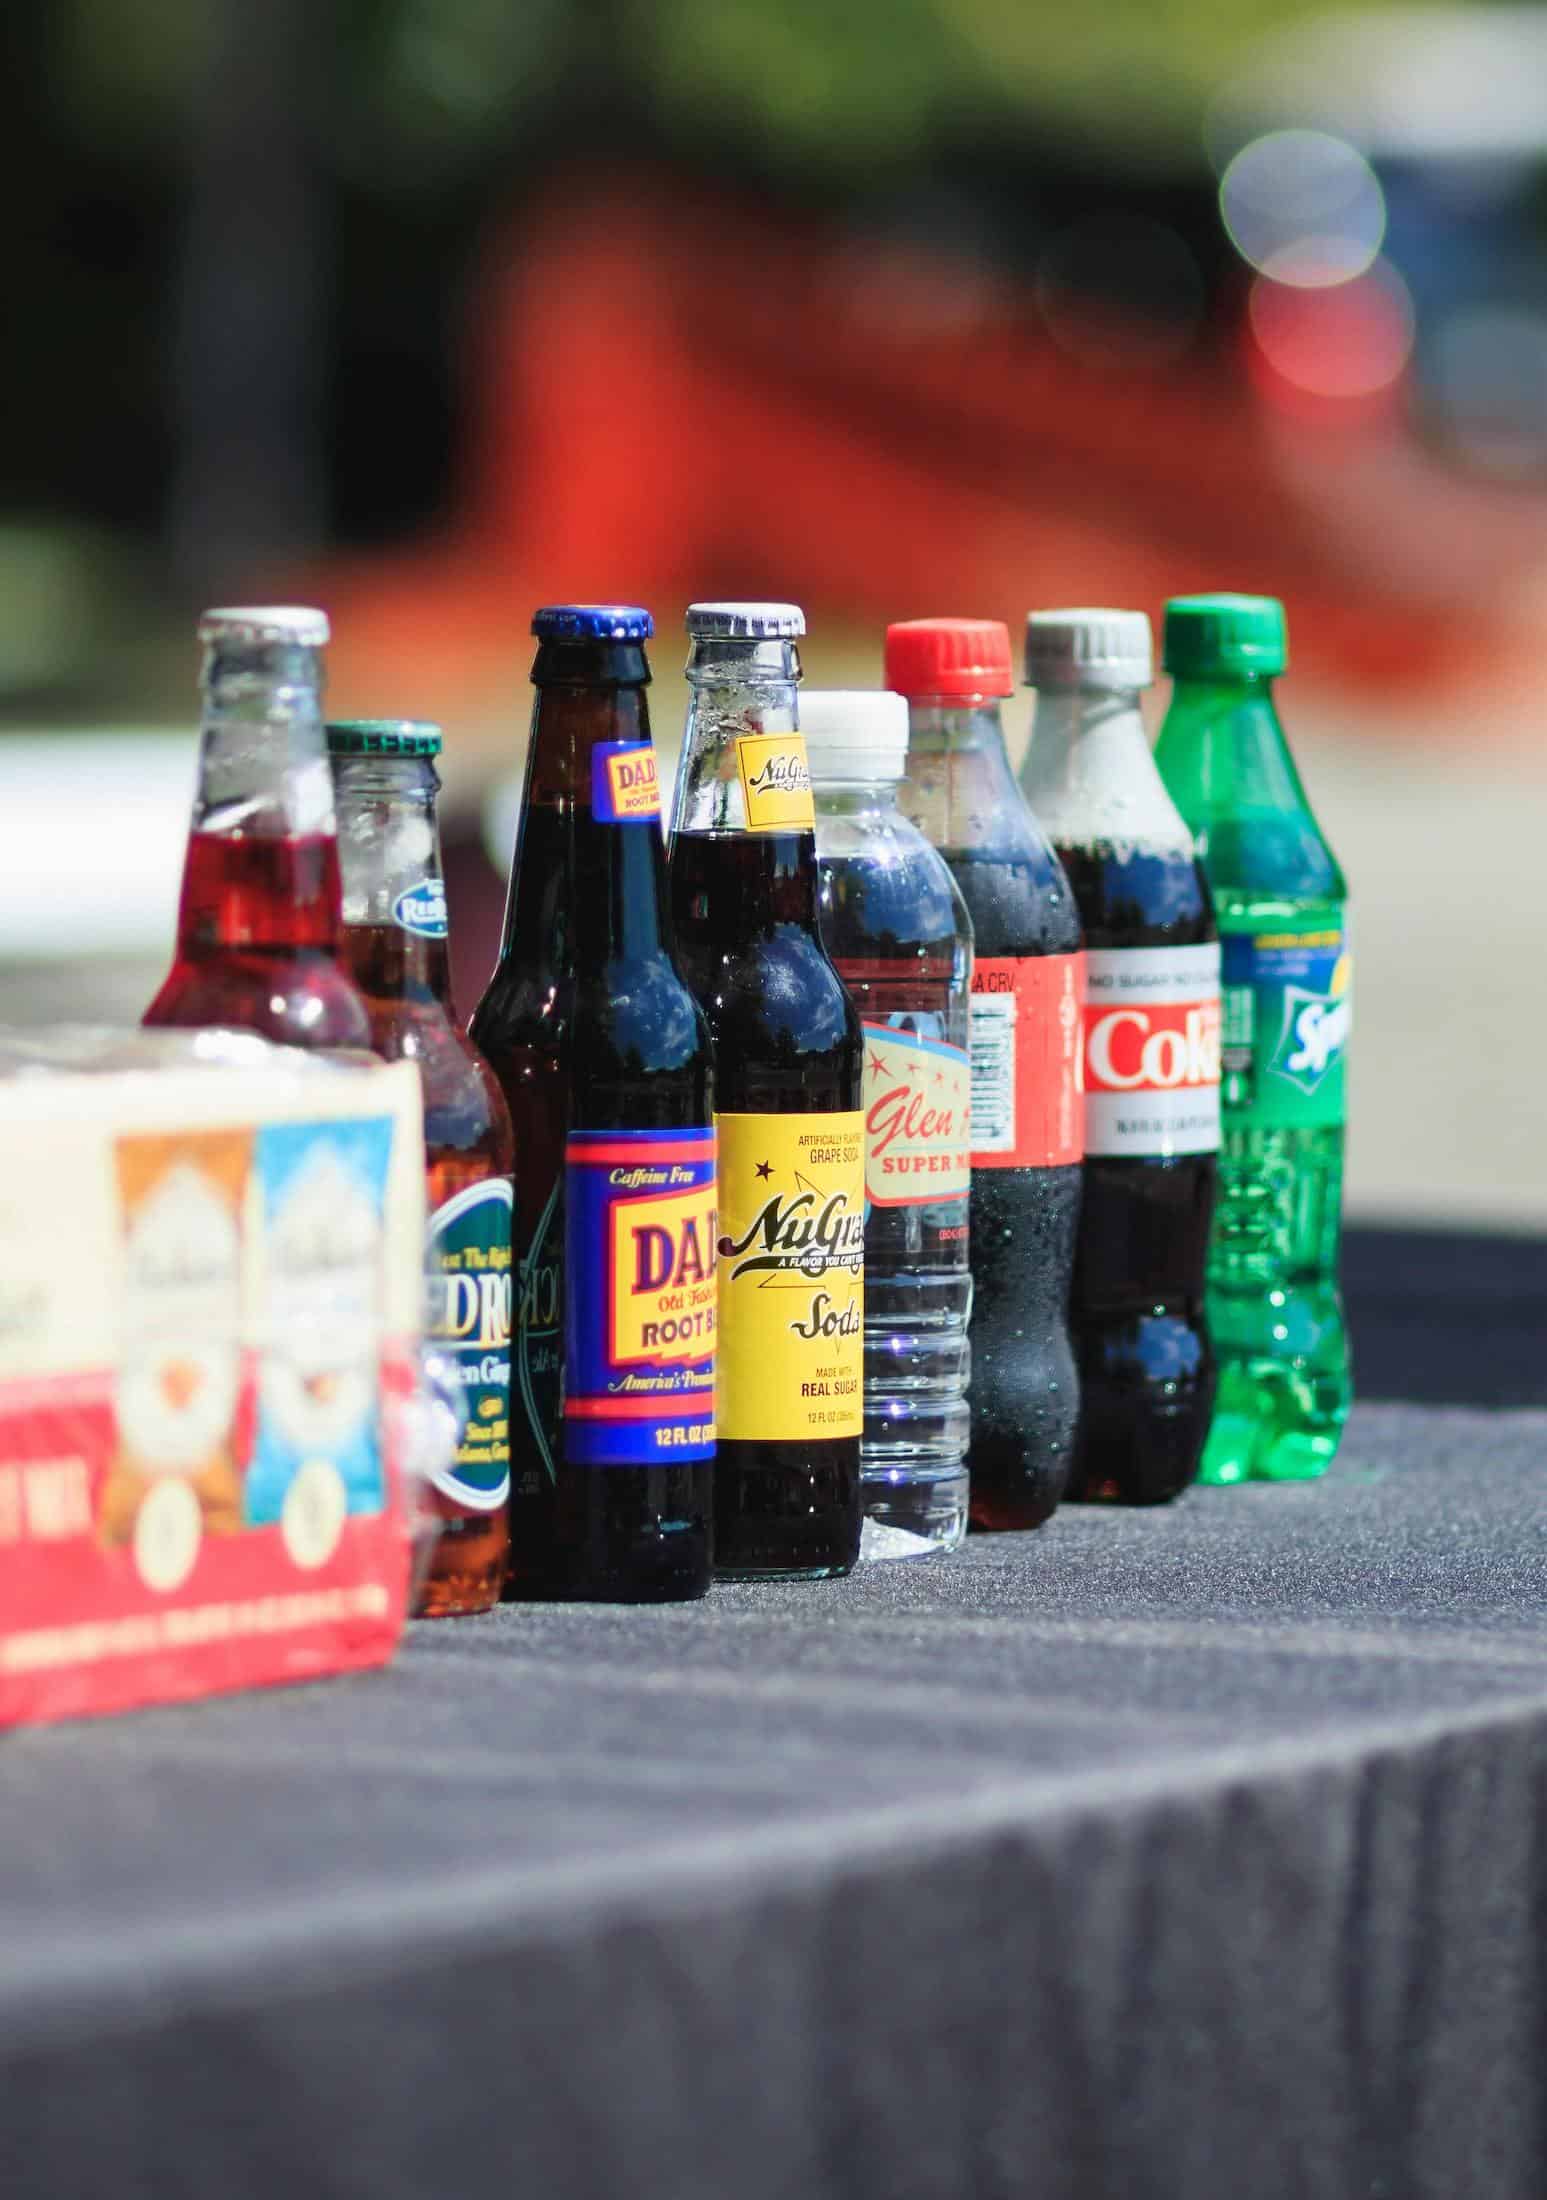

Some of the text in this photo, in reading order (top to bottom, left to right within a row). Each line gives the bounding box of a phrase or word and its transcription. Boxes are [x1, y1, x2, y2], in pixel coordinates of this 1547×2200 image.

[865, 1085, 953, 1158] Glen
[810, 1149, 840, 1164] GRAPE
[882, 1156, 951, 1174] SUPER
[609, 1167, 667, 1188] Caffeine
[777, 1257, 788, 1268] A
[789, 1255, 824, 1268] FLAVOR
[658, 1295, 683, 1313] Old
[641, 1312, 703, 1348] ROOT
[815, 1367, 837, 1378] MADE
[801, 1383, 831, 1397] REAL
[656, 1429, 671, 1446] 12
[674, 1428, 687, 1445] FL
